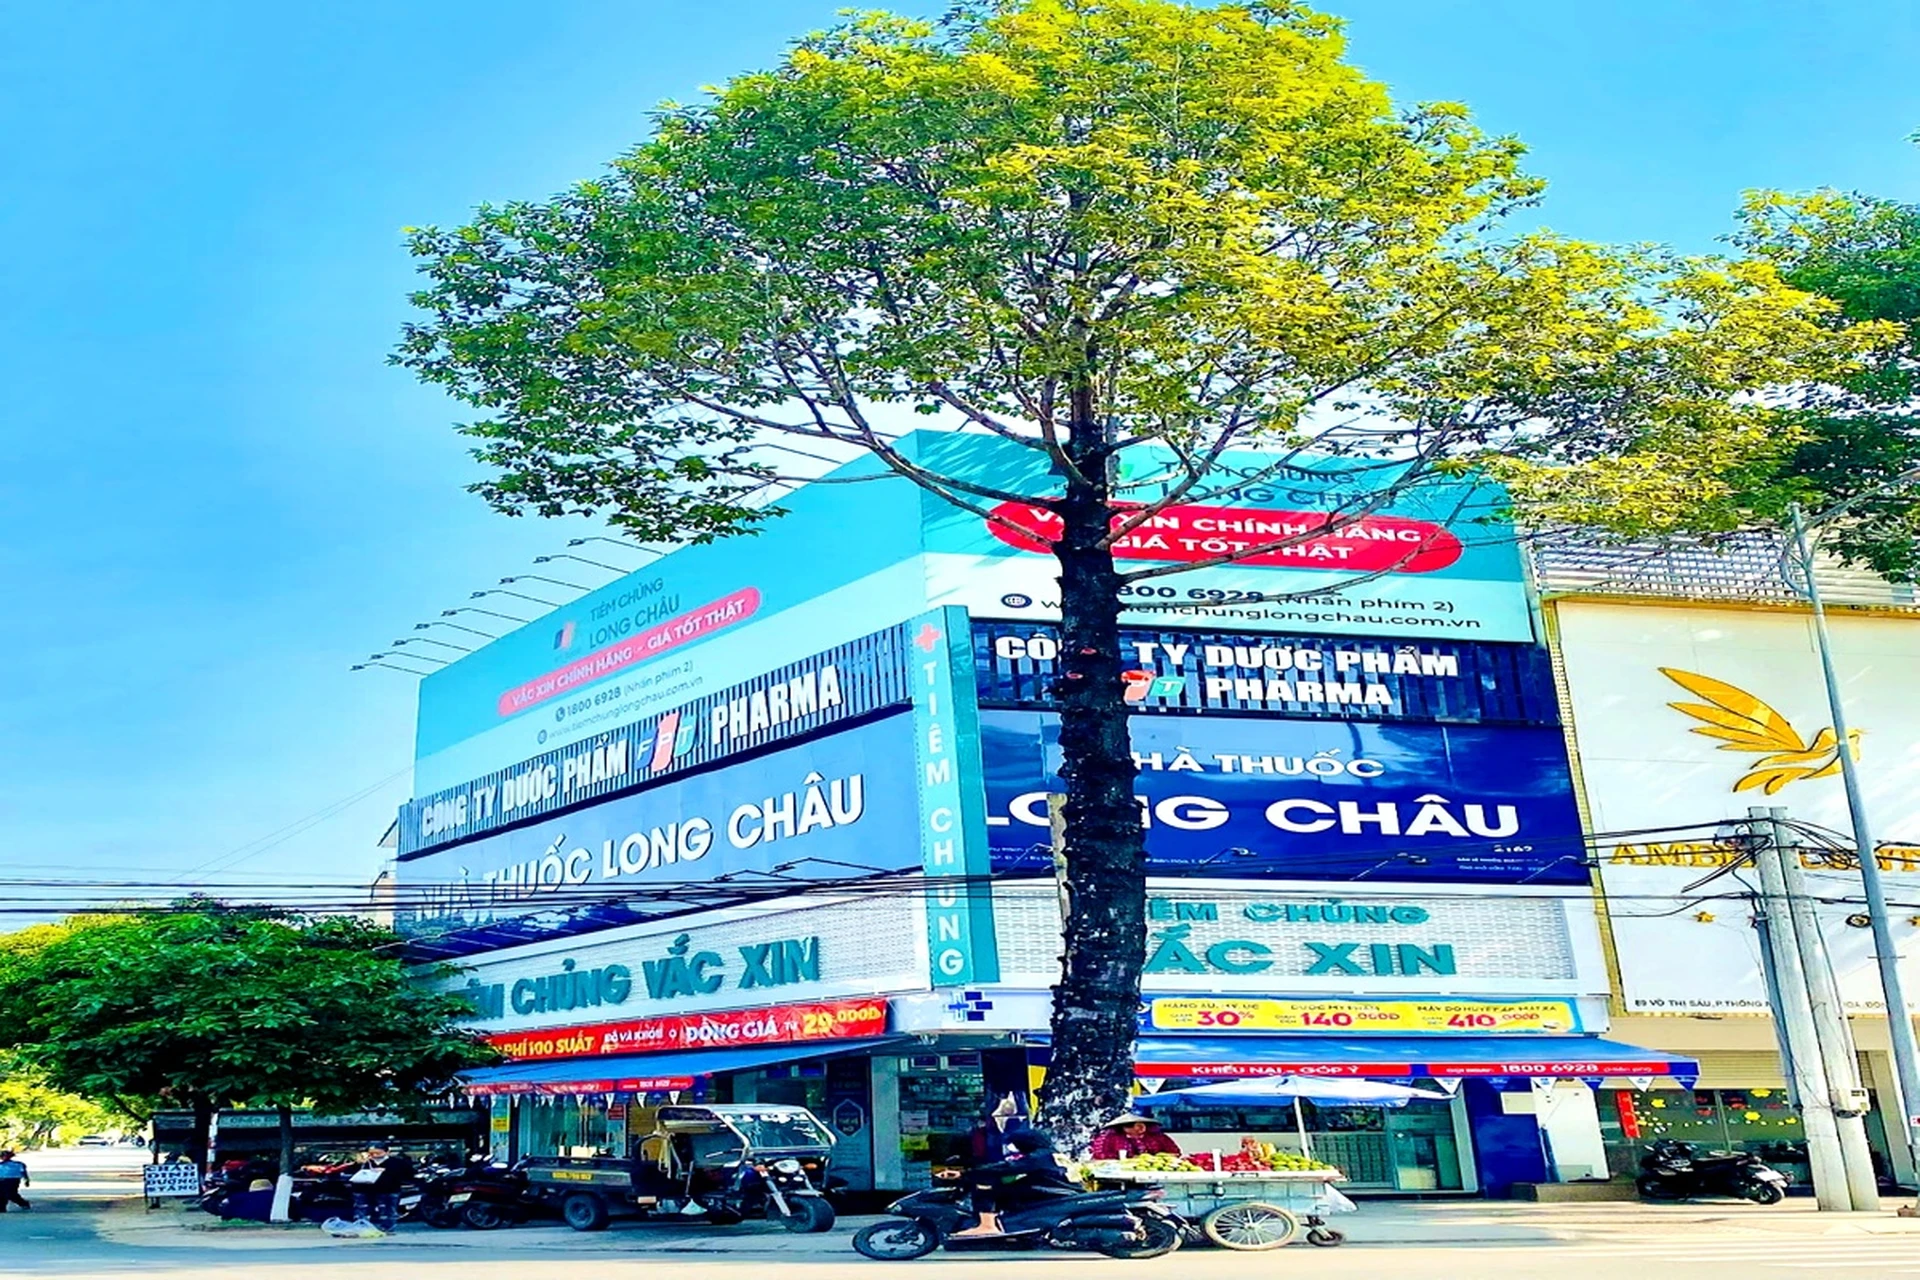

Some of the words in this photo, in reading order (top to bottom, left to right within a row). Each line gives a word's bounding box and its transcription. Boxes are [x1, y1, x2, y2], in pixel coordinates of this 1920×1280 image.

[1192, 517, 1307, 536] CHÍNH
[1112, 532, 1169, 549] GIÁ
[1178, 535, 1246, 554] TỐT
[1117, 585, 1177, 598] 800
[1188, 588, 1264, 602] 6928
[1361, 597, 1426, 613] phím
[1431, 600, 1455, 614] 2)
[589, 619, 632, 650] LONG
[635, 594, 680, 628] CHÂU
[647, 627, 672, 649] GIÁ
[674, 615, 702, 639] TỐT
[705, 598, 745, 626] THẬT
[995, 633, 1064, 661] CÔ
[1133, 641, 1190, 666] TY
[1205, 645, 1323, 674] DƯỢC
[1335, 645, 1459, 677] PHẨM
[567, 698, 591, 716] 1800
[595, 686, 622, 707] 6928
[1206, 678, 1394, 706] PHARMA
[923, 660, 951, 787] TIÊM
[422, 794, 468, 837] CÔNG
[474, 784, 499, 822] TY
[503, 763, 558, 814] DƯỢC
[564, 734, 630, 794] PHẨM
[711, 664, 843, 746] PHARMA
[1131, 746, 1205, 773] HÀ
[1213, 749, 1385, 778] THUỐC
[1265, 793, 1519, 838] CHÂU
[482, 833, 593, 903] THUỐC
[602, 817, 713, 879] LONG
[728, 771, 864, 842] CHÂU
[1150, 897, 1219, 922] ÊM
[1243, 898, 1429, 925] CHỦNG
[511, 958, 632, 1015] CHỦNG
[642, 933, 724, 1000] VẮC
[738, 936, 820, 989] XIN
[1304, 942, 1457, 975] XIN
[742, 1015, 779, 1039] GIÁ
[504, 1037, 528, 1057] PHÍ
[529, 1039, 554, 1056] 100
[556, 1030, 595, 1054] SUẤT
[1501, 1063, 1546, 1073] 1800
[1551, 1063, 1599, 1073] 6928
